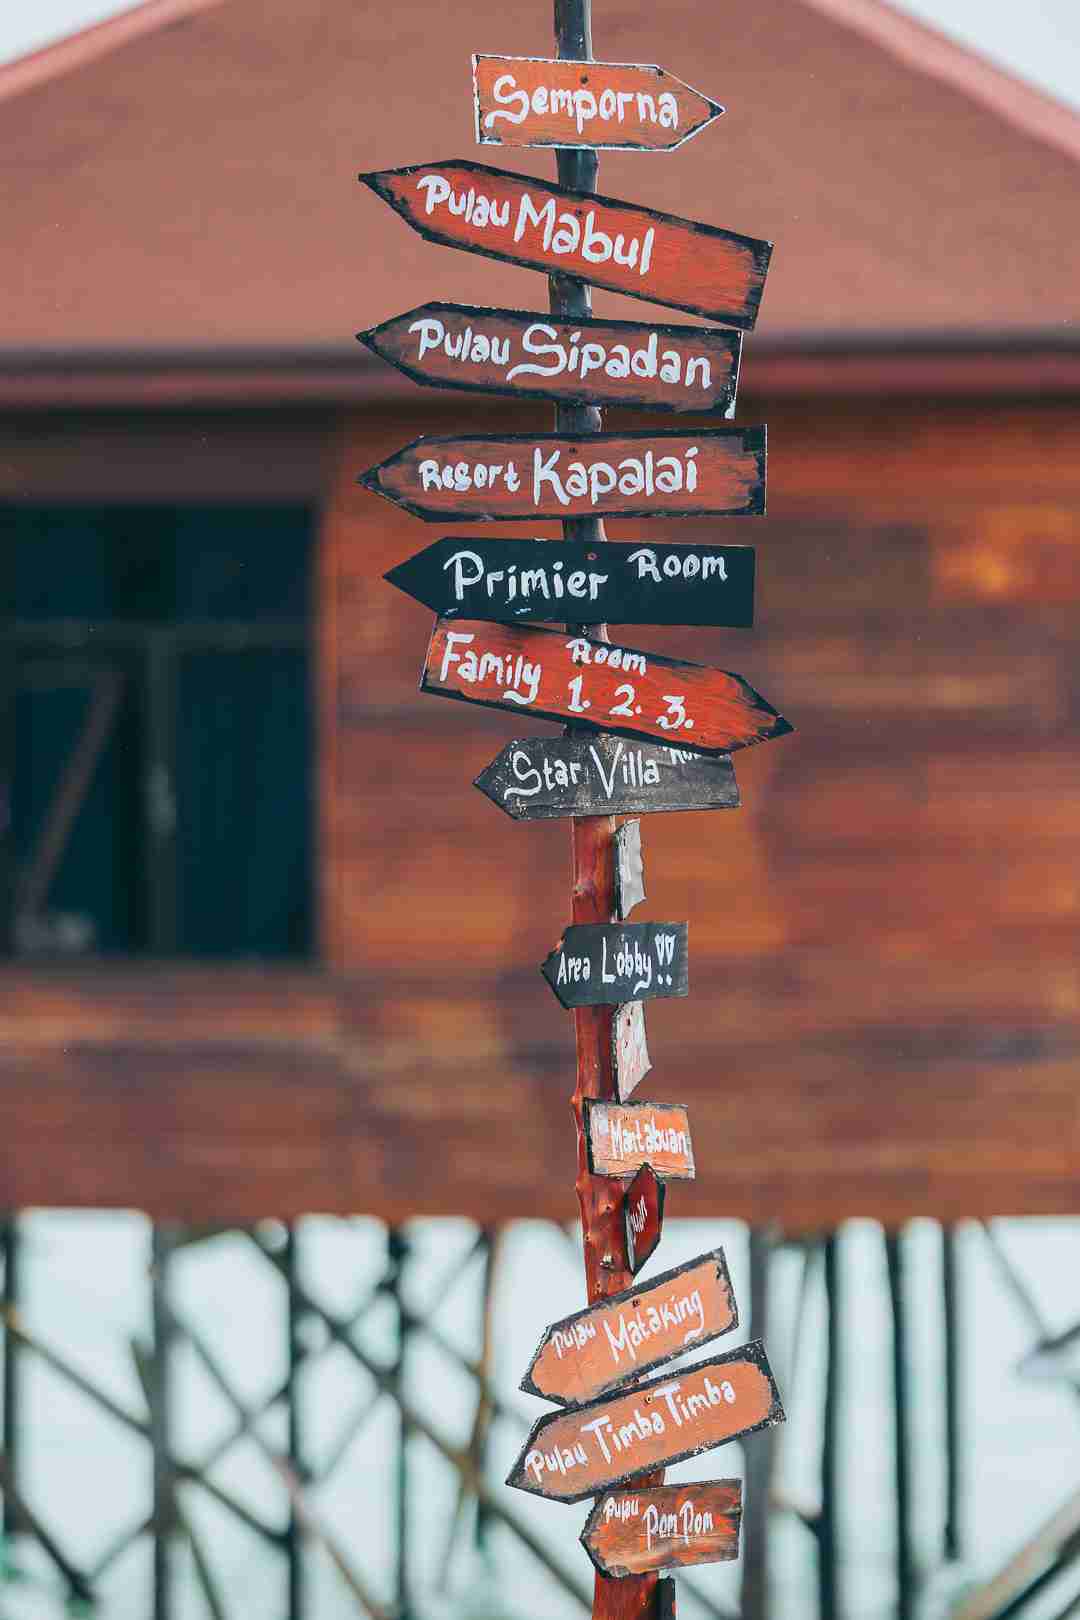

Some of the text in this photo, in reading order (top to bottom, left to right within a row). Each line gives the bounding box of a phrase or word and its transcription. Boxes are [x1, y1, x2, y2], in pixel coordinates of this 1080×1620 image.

[485, 75, 678, 134] Semporna
[417, 175, 655, 275] Pulau Mabul
[408, 319, 713, 389] Pulau Sipadan
[418, 447, 699, 506] Resort Kapalai
[443, 549, 728, 600] Primier Room
[440, 632, 647, 704] Family Room
[504, 743, 661, 799] Star Villa
[557, 952, 591, 985] Area
[602, 1290, 705, 1362] Mataking
[525, 1377, 736, 1483] Pulau Timba Timba
